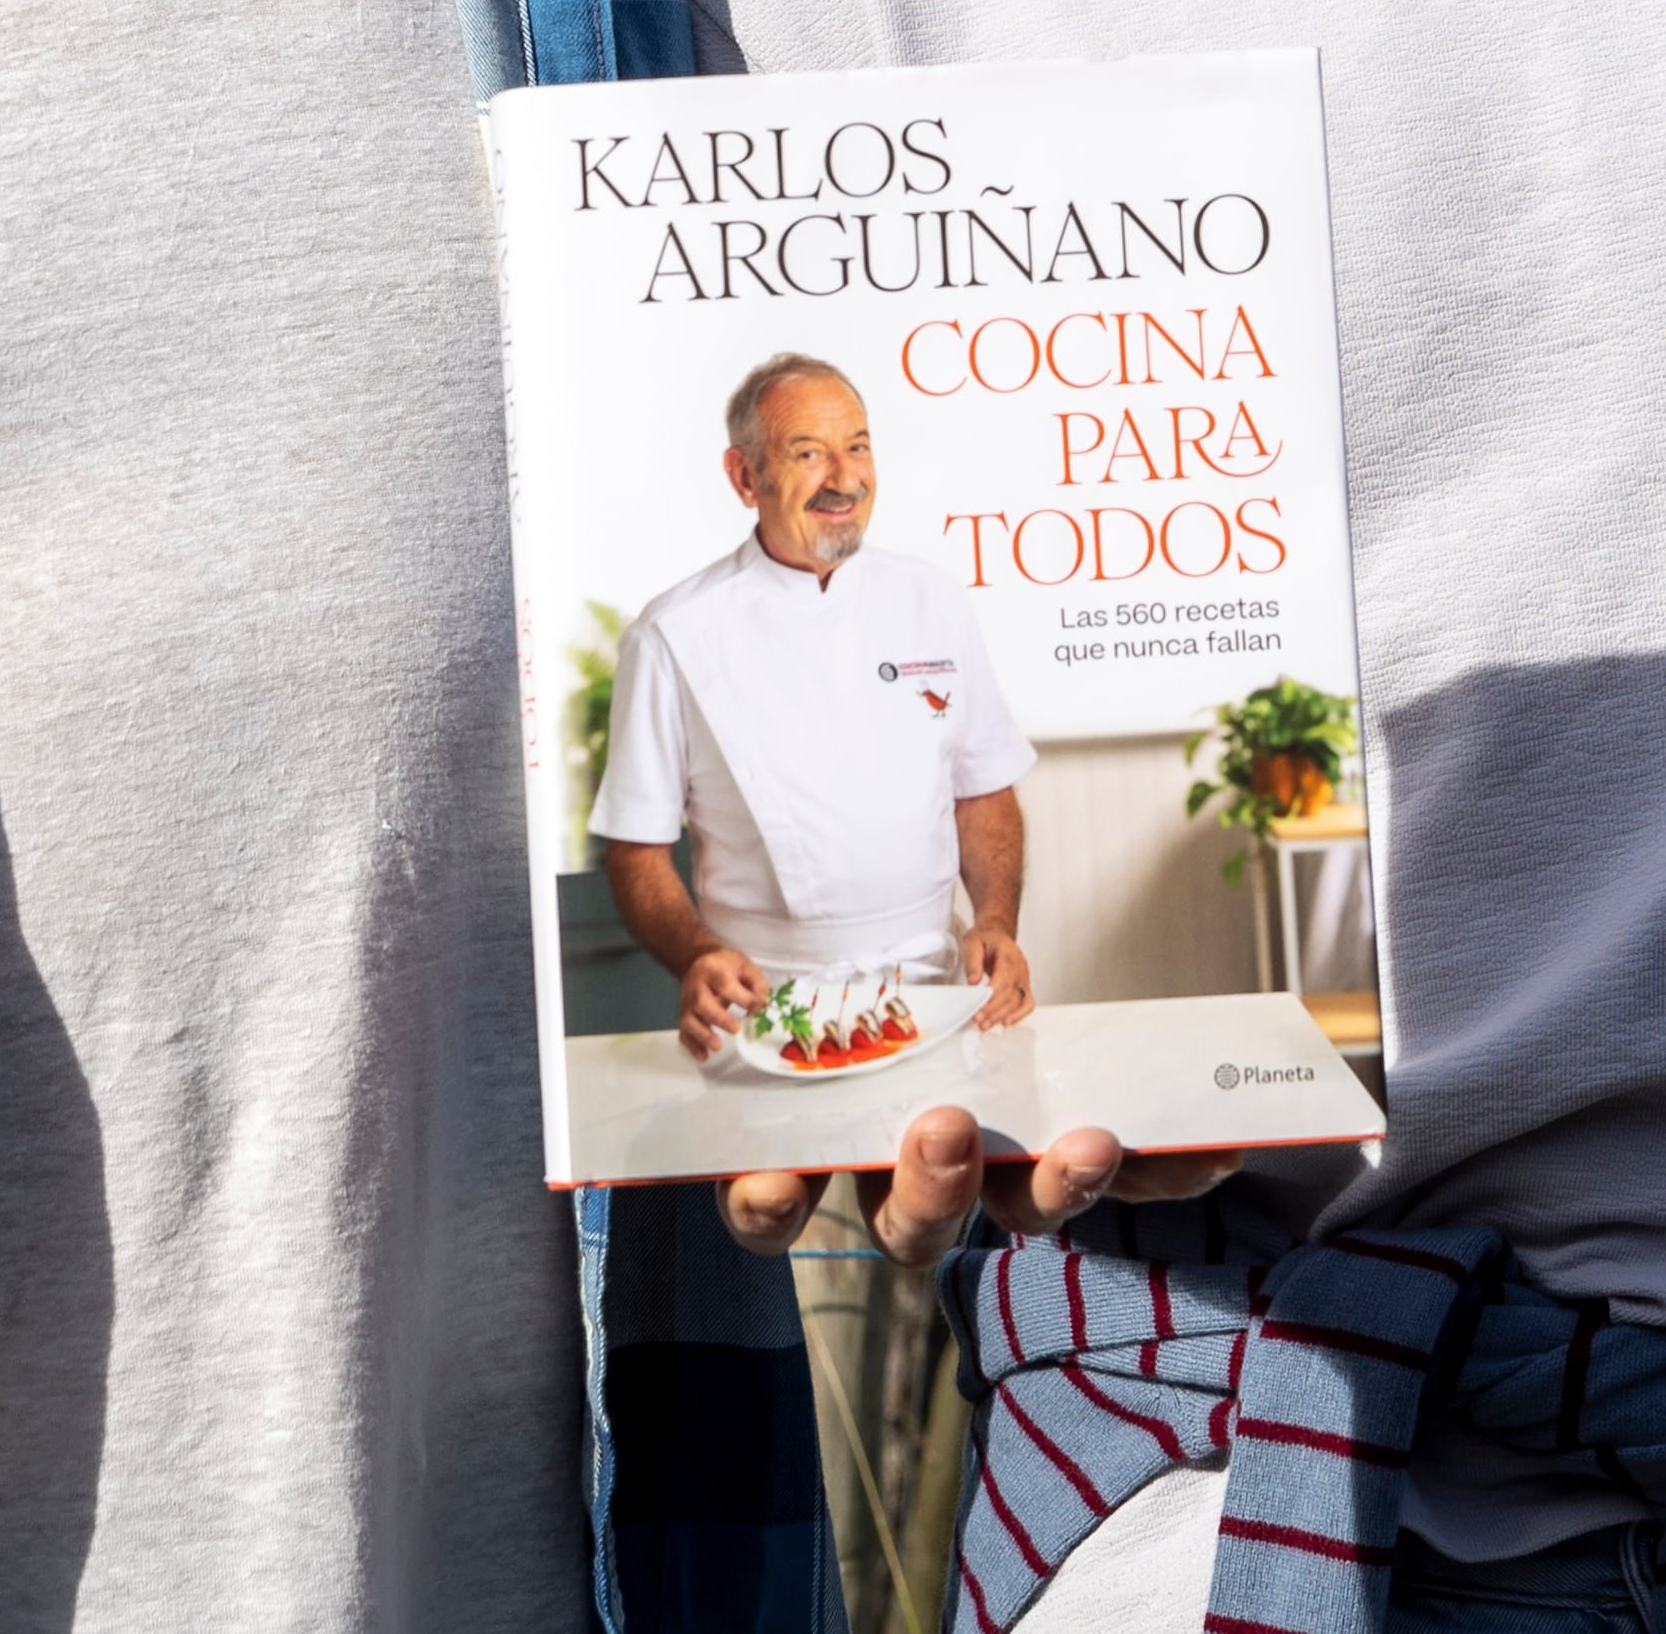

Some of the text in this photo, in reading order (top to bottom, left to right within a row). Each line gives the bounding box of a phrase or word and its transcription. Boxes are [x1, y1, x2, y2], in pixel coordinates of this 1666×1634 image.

[571, 116, 954, 213] KARLOS
[639, 184, 1272, 304] ARGUIÑANO
[900, 304, 1278, 397] COCINA
[1053, 400, 1284, 486] PARA
[943, 496, 1287, 588] TODOS
[1054, 629, 1282, 667] que nunca fallan
[1059, 597, 1281, 629] Las 560 recetas
[1244, 1065, 1315, 1084] Planeta
